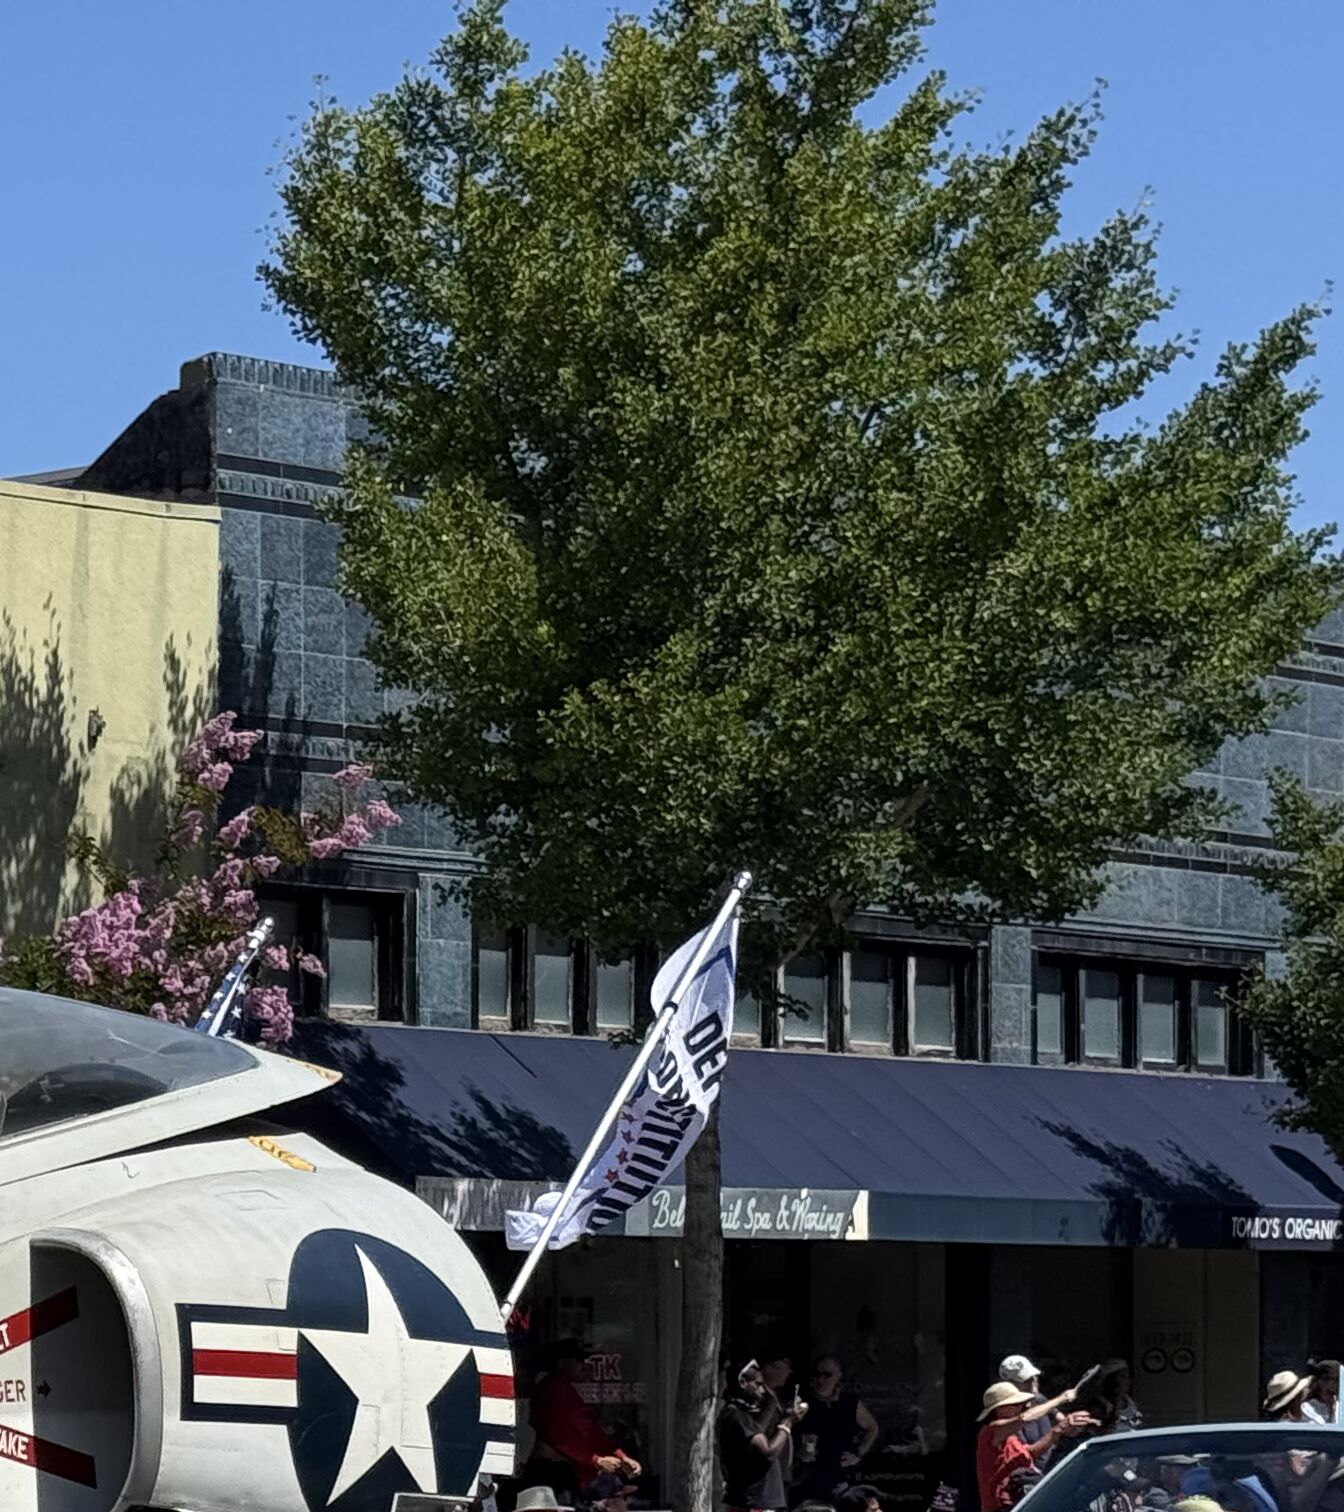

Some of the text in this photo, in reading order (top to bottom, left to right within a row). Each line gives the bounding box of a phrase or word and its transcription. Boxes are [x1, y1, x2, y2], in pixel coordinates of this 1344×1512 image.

[744, 1197, 772, 1236] Spa
[776, 1194, 790, 1231] &
[792, 1196, 844, 1239] Waxing
[1285, 1218, 1342, 1240] ORGANIC
